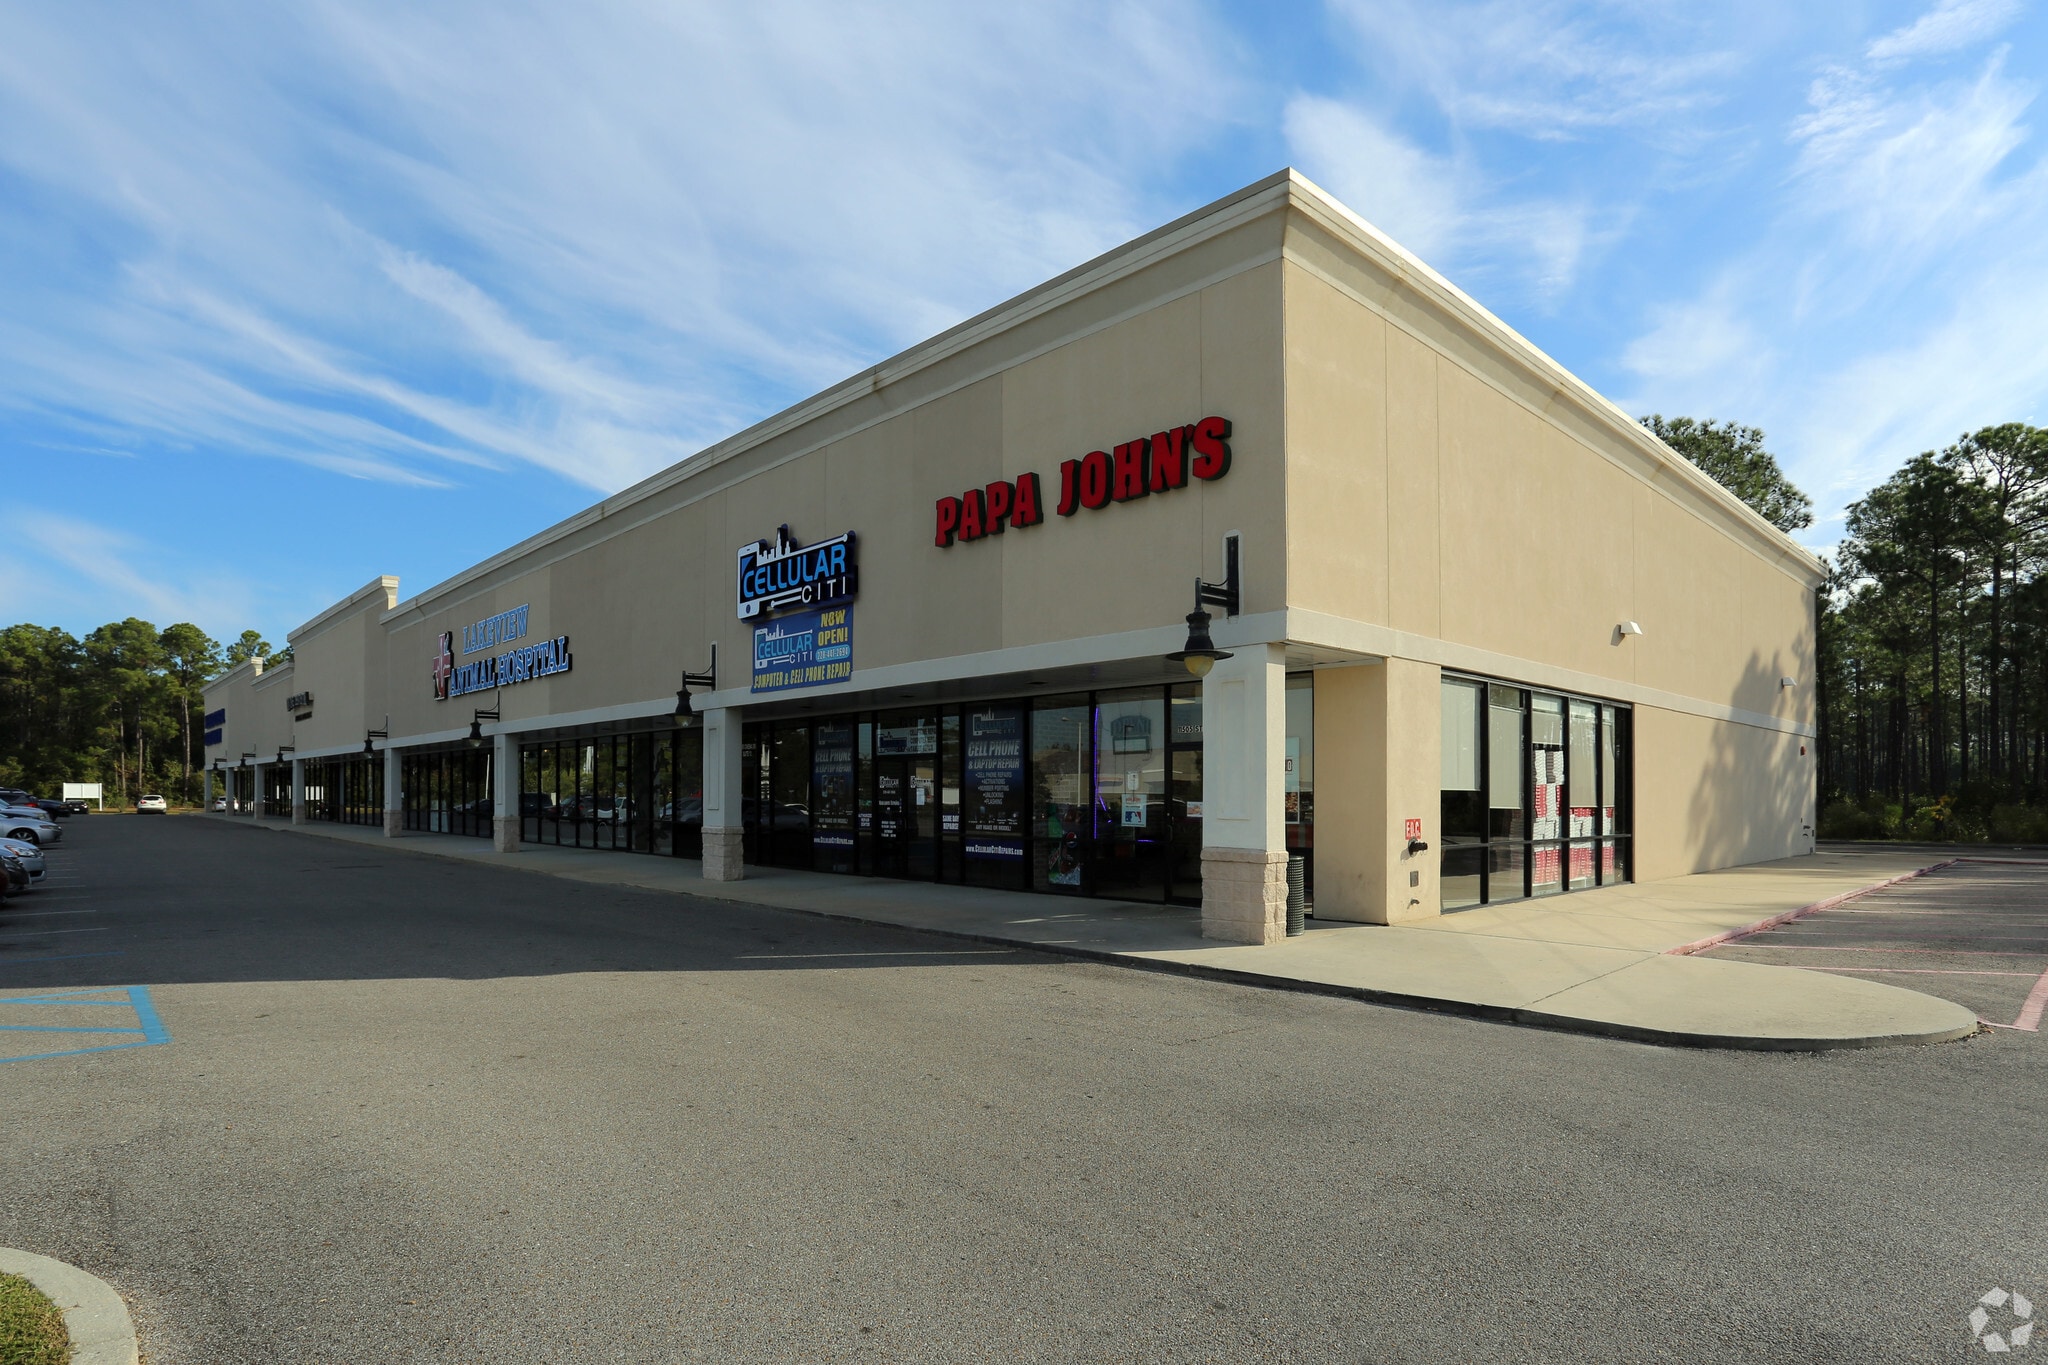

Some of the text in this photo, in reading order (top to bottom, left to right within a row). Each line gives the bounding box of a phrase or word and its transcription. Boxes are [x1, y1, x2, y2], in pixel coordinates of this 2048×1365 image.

[935, 416, 1232, 547] PAPA JOHN'S
[743, 544, 846, 598] CELLULAR
[801, 576, 846, 603] CITI
[463, 603, 529, 655] LAKEVIEW
[821, 609, 847, 628] NOW
[758, 634, 813, 659] CELLULAR
[818, 627, 849, 646] OPEN!
[450, 635, 570, 697] ANIMAL HOSPITAL
[789, 651, 813, 664] CITI
[754, 672, 783, 689] COMPUTER
[790, 668, 804, 685] CELL
[805, 665, 825, 682] PHONE
[826, 662, 850, 679] REPAIR
[815, 748, 852, 763] CELL PHONE
[968, 740, 1020, 757] CELL PHONE
[968, 758, 1020, 769] & LAPTOP REPAIR
